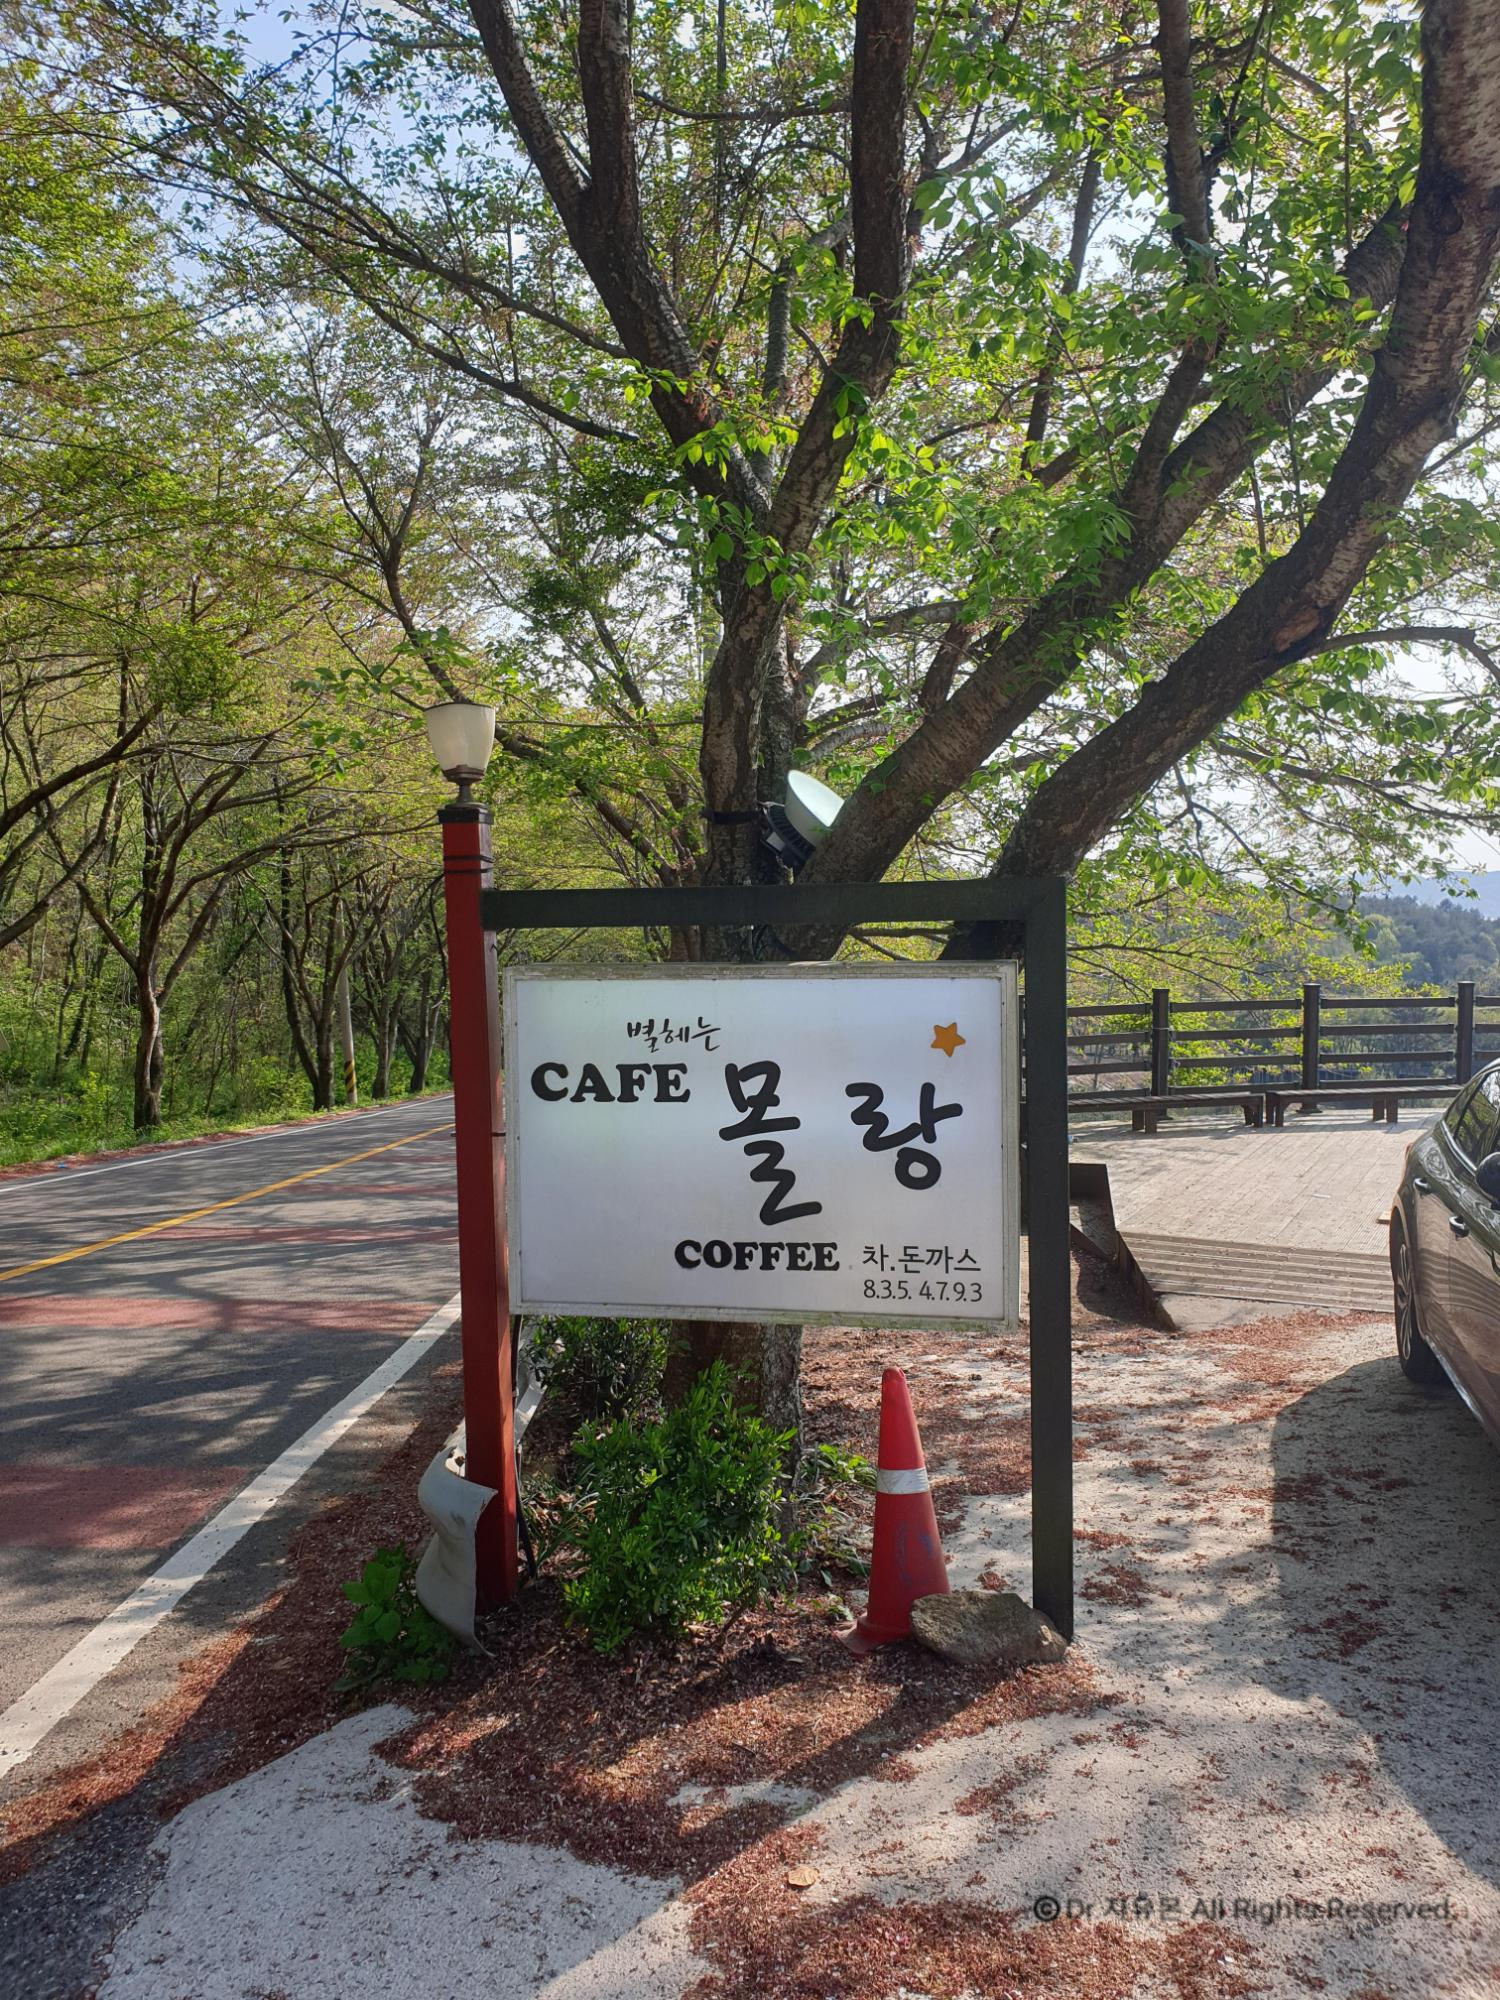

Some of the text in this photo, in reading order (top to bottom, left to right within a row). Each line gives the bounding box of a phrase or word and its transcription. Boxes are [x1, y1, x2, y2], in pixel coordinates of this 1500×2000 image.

[626, 1016, 721, 1053] 별헤는
[530, 1060, 964, 1226] CAFE 몰랑
[674, 1239, 982, 1274] COFFEE 차.돈까스
